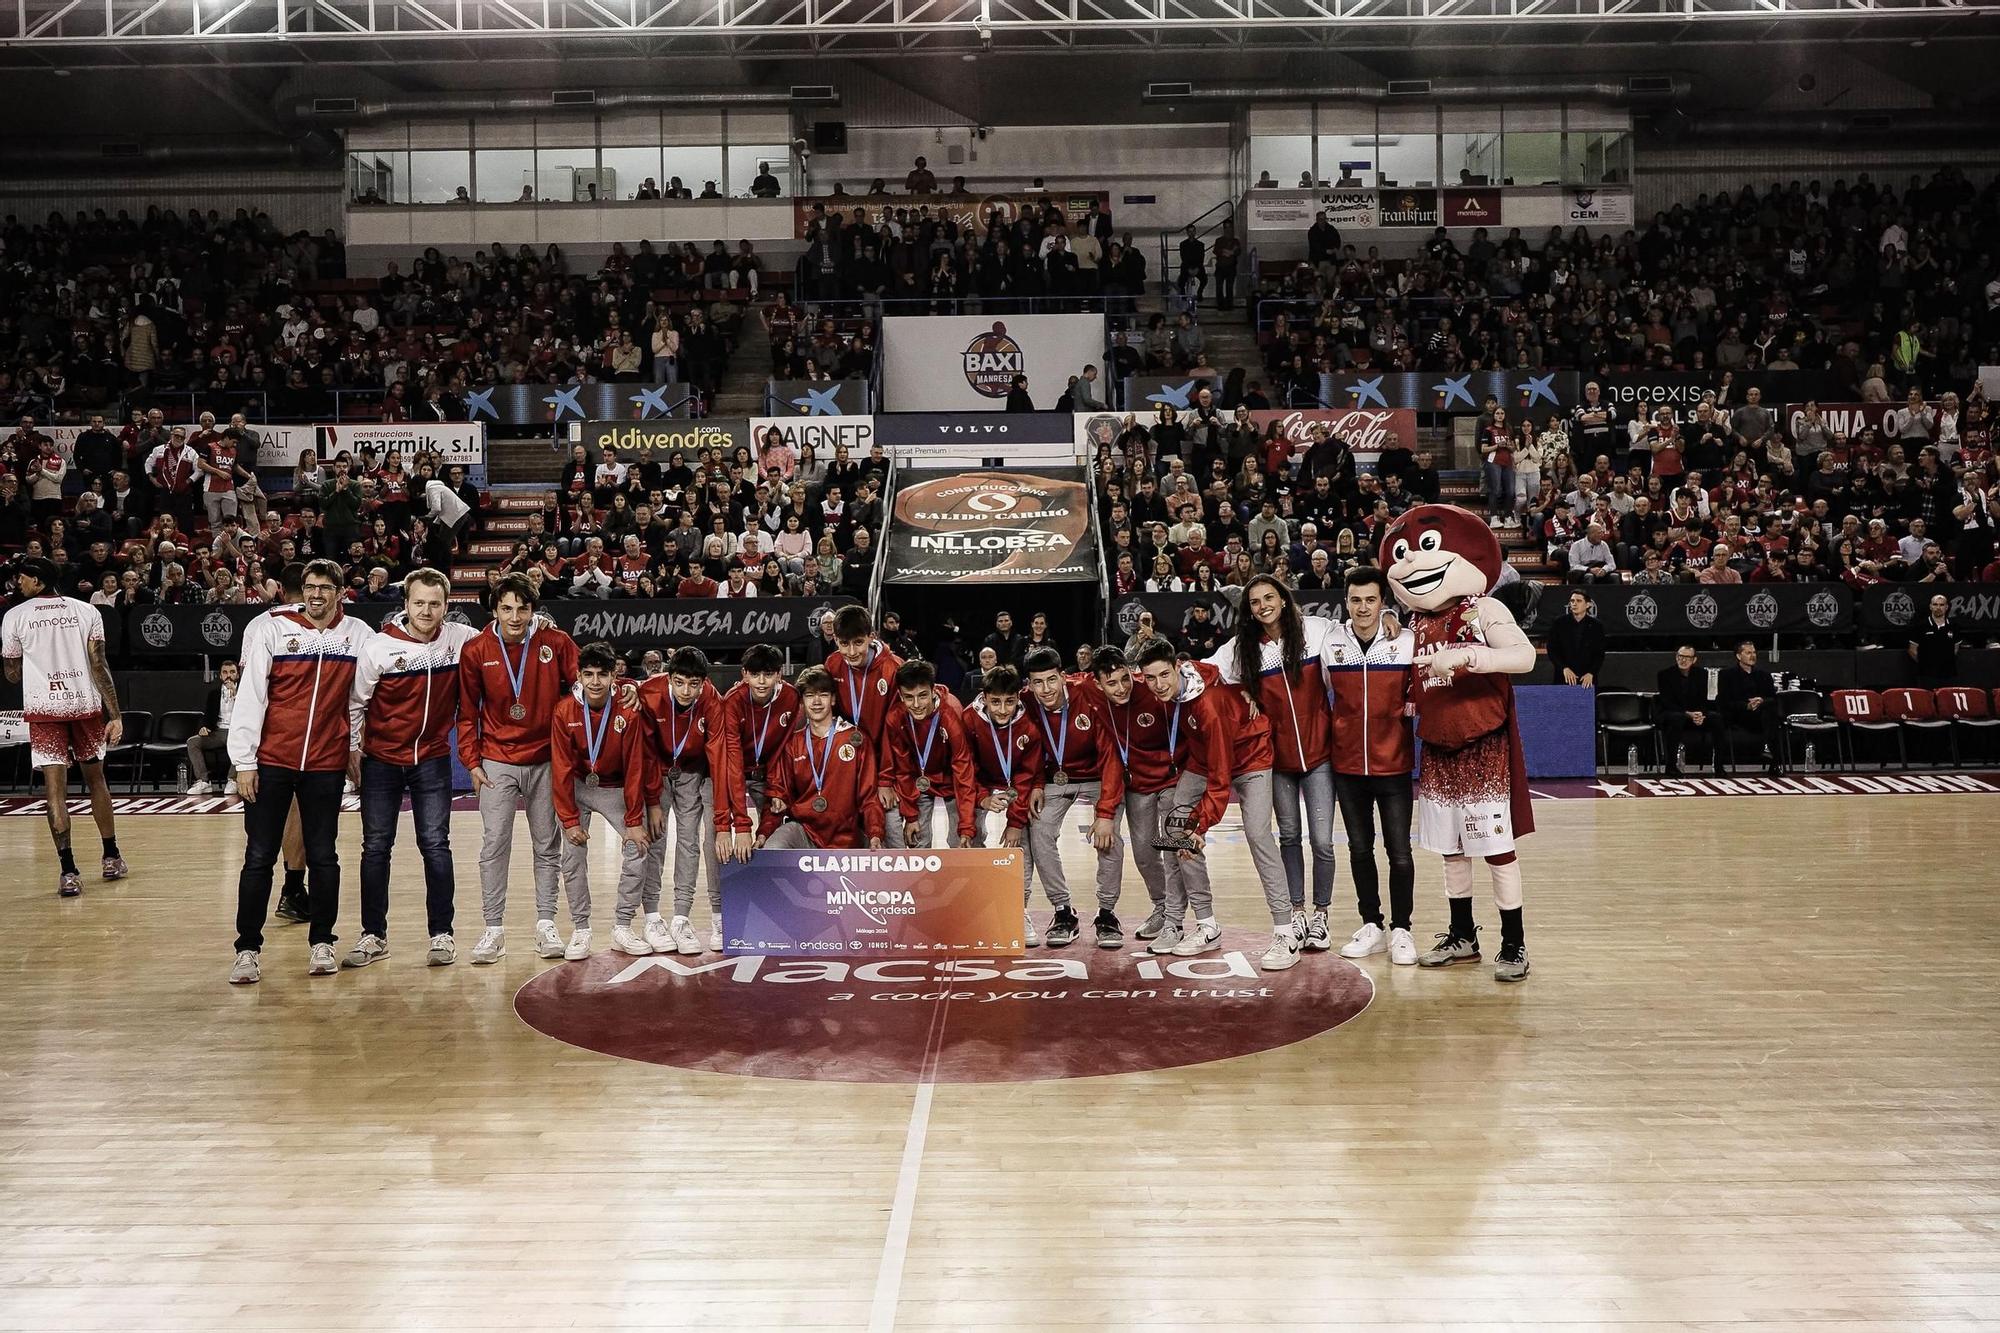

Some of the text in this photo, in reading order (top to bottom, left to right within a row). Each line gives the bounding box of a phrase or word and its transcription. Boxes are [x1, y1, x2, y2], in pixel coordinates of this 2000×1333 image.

[1321, 194, 1374, 204] JUANOLA
[1380, 208, 1437, 224] frankfurt
[1571, 211, 1599, 219] CEM
[966, 352, 1022, 372] BAXI
[976, 374, 1013, 384] MANRESA
[699, 426, 721, 434] .com
[939, 424, 1008, 433] VOLVO
[1283, 411, 1394, 449] Coc-Cola
[353, 430, 413, 439] construccions
[598, 428, 733, 451] eldivendres
[257, 431, 291, 449] ALT
[451, 435, 480, 453] s.l.
[915, 447, 947, 455] Premium
[936, 484, 1048, 498] CONSTRUCCIONS
[914, 507, 1070, 521] SALIDO CARRIÓ
[910, 532, 1072, 550] INLLOBSA
[925, 545, 1056, 555] IMMOBILIARIA
[897, 564, 1084, 577] www.grupsalido.com
[1628, 605, 1657, 615] BAXI
[1688, 605, 1717, 615] BAXI
[1749, 604, 1777, 614] BAXI
[1808, 603, 1838, 613] BAXI
[1885, 603, 1913, 612] BAXI
[143, 624, 172, 634] BAXI
[203, 623, 231, 633] BAXI
[573, 610, 792, 639] BAXIMANRESA.COM
[50, 681, 69, 691] ETL
[48, 690, 87, 701] GLOBAL
[1845, 695, 1870, 715] 00
[1903, 691, 1913, 712] 1
[1953, 692, 1969, 710] 11
[5, 729, 11, 740] 5
[1634, 775, 2000, 796] ESTRELLA DAMM
[1169, 818, 1187, 826] MV
[1466, 823, 1478, 832] ETL
[1466, 831, 1491, 841] GLOBAL
[798, 855, 942, 873] CLASIFICADO
[871, 906, 916, 915] endesa
[800, 940, 843, 950] endesa
[607, 951, 1259, 983] Macsa id
[827, 985, 1275, 1003] a code you can trust
